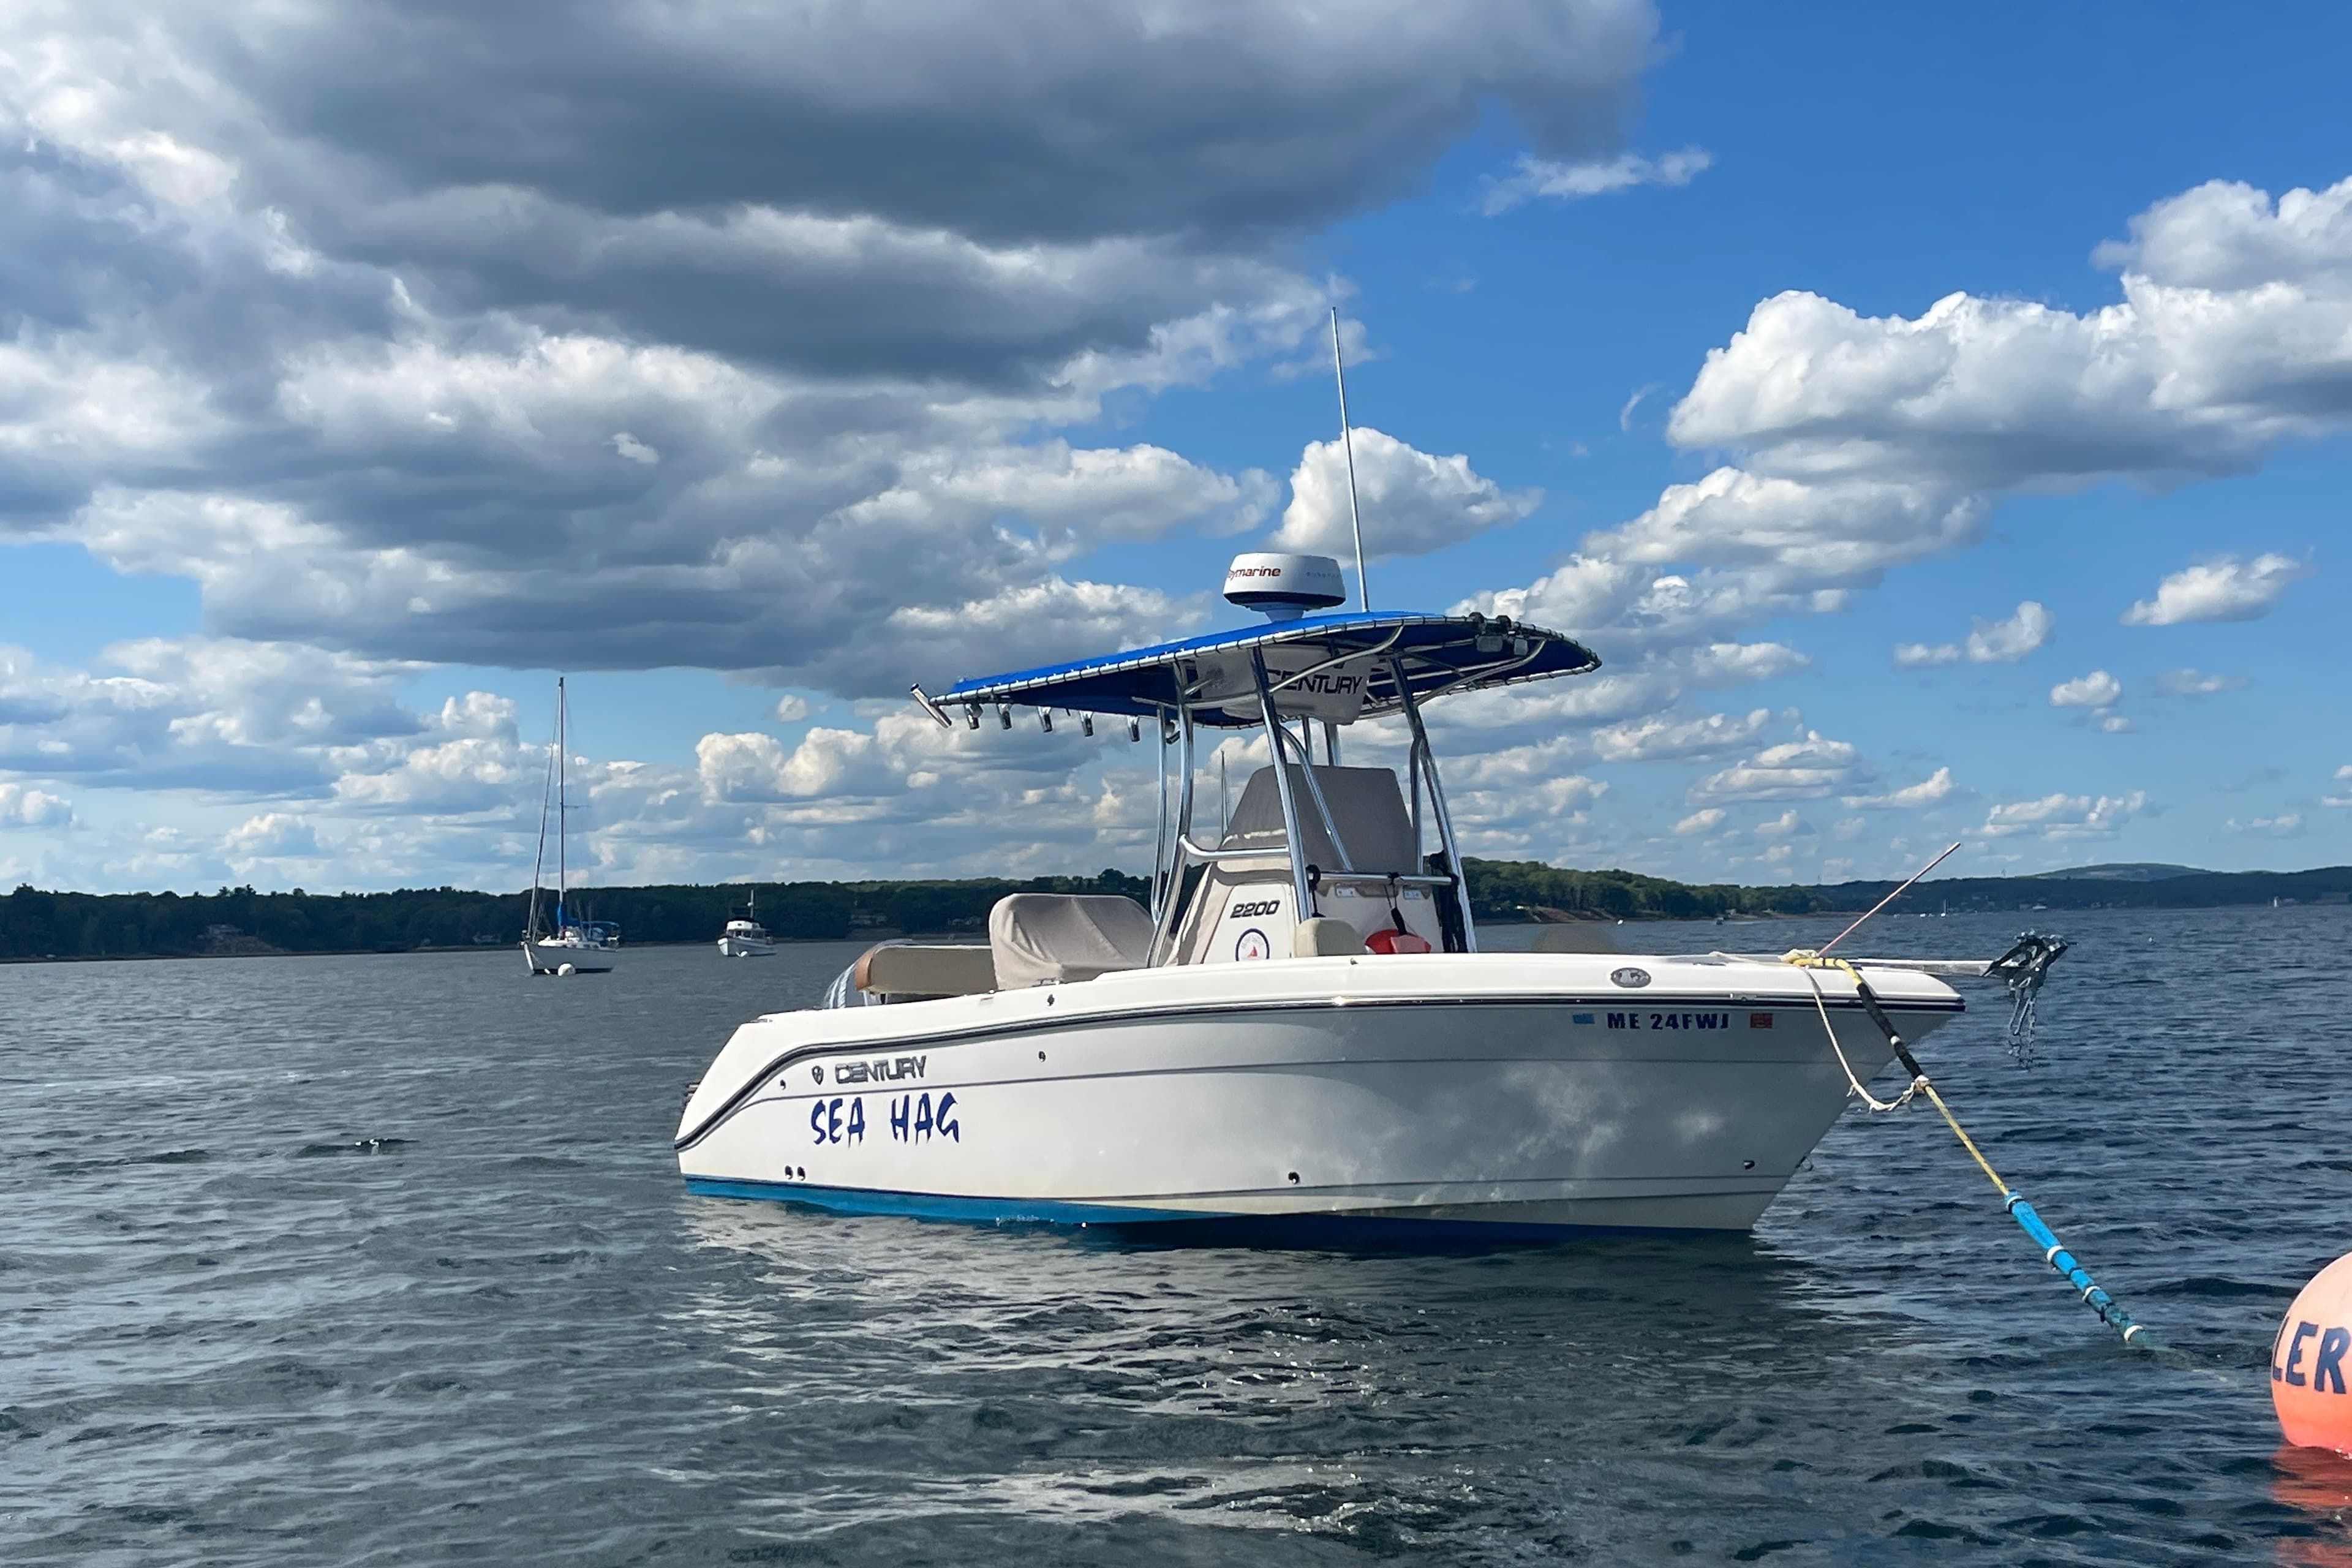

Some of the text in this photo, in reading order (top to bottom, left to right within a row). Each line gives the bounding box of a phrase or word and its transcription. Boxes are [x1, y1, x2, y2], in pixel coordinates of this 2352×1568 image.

[1230, 900, 1281, 919] 2200
[1607, 1012, 1640, 1030] ME
[835, 1055, 927, 1084] CENTURY
[811, 1092, 960, 1148] SEA HAG
